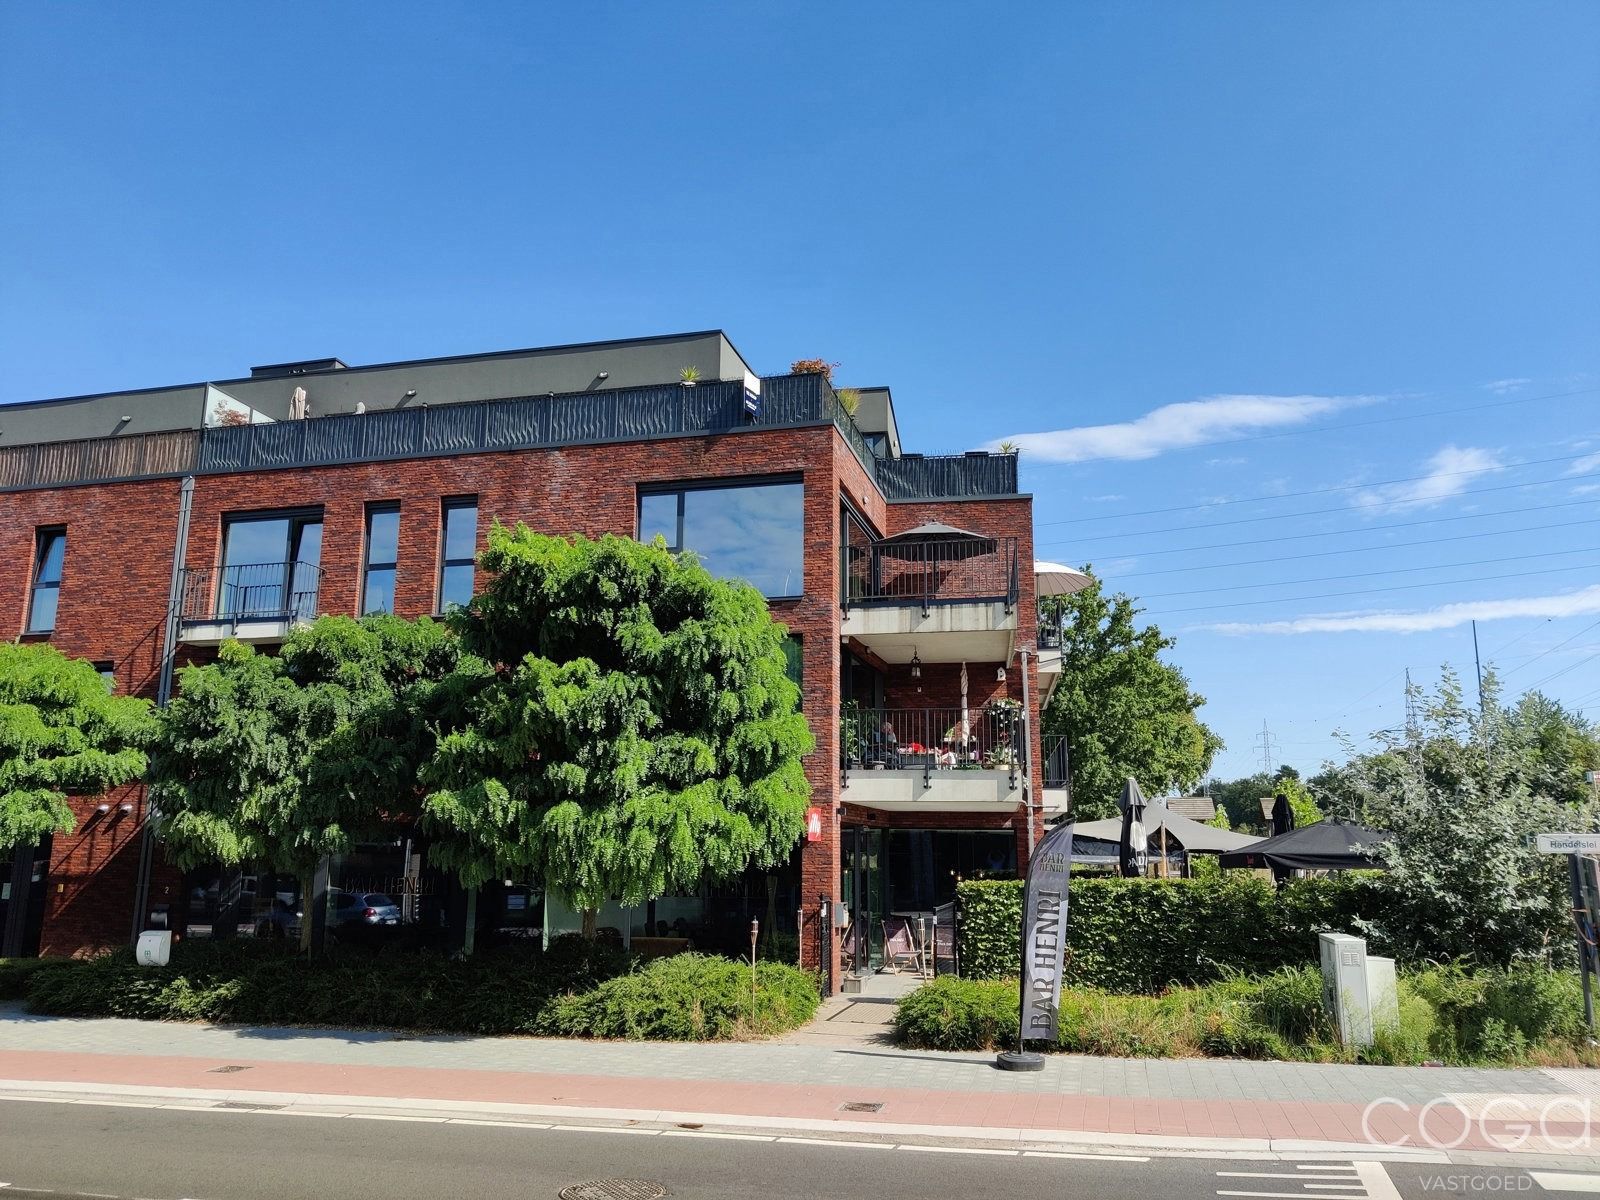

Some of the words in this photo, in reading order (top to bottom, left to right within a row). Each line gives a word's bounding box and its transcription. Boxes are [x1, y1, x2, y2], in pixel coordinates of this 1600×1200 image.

[1550, 840, 1597, 849] Handelslei
[1041, 852, 1065, 864] BAR
[1040, 863, 1064, 873] HENRI
[345, 876, 377, 894] BAR
[384, 876, 436, 895] HENRI
[1034, 889, 1062, 970] HENRI
[1030, 977, 1055, 1030] BAR
